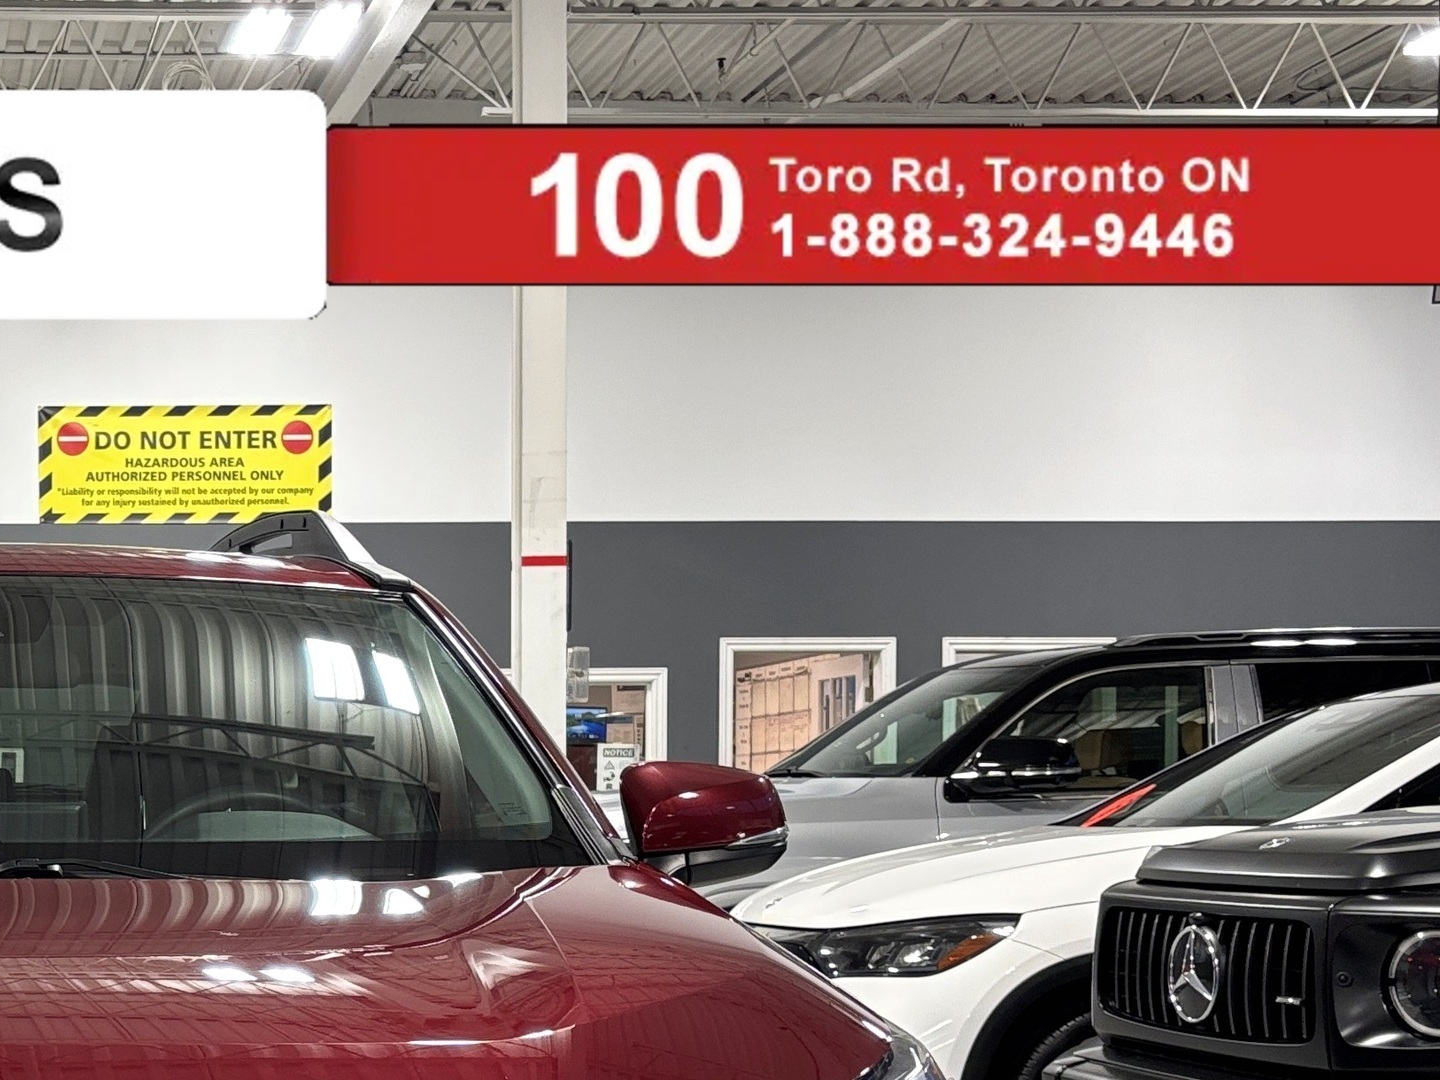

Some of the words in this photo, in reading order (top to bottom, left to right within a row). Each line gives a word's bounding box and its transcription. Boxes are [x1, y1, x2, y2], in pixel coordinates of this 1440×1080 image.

[94, 431, 131, 450] DO
[140, 431, 191, 450] NOT
[199, 430, 277, 449] ENTER
[125, 457, 205, 468] HAZARDOUS
[209, 457, 245, 467] AREA
[85, 471, 167, 482] AUTHORIZED
[171, 470, 246, 481] PERSONNEL
[250, 470, 284, 480] ONLY
[107, 487, 162, 497] responsibility
[164, 487, 180, 495] will
[181, 487, 195, 495] not
[197, 487, 208, 495] be
[210, 487, 247, 496] accepted
[249, 487, 259, 496] by
[277, 488, 314, 496] company
[81, 498, 94, 506] for
[95, 499, 110, 508] any
[138, 498, 177, 506] sustained
[179, 498, 189, 507] by
[191, 497, 245, 506] unauthorized
[247, 497, 290, 507] personnel.
[603, 748, 634, 757] NOTICE
